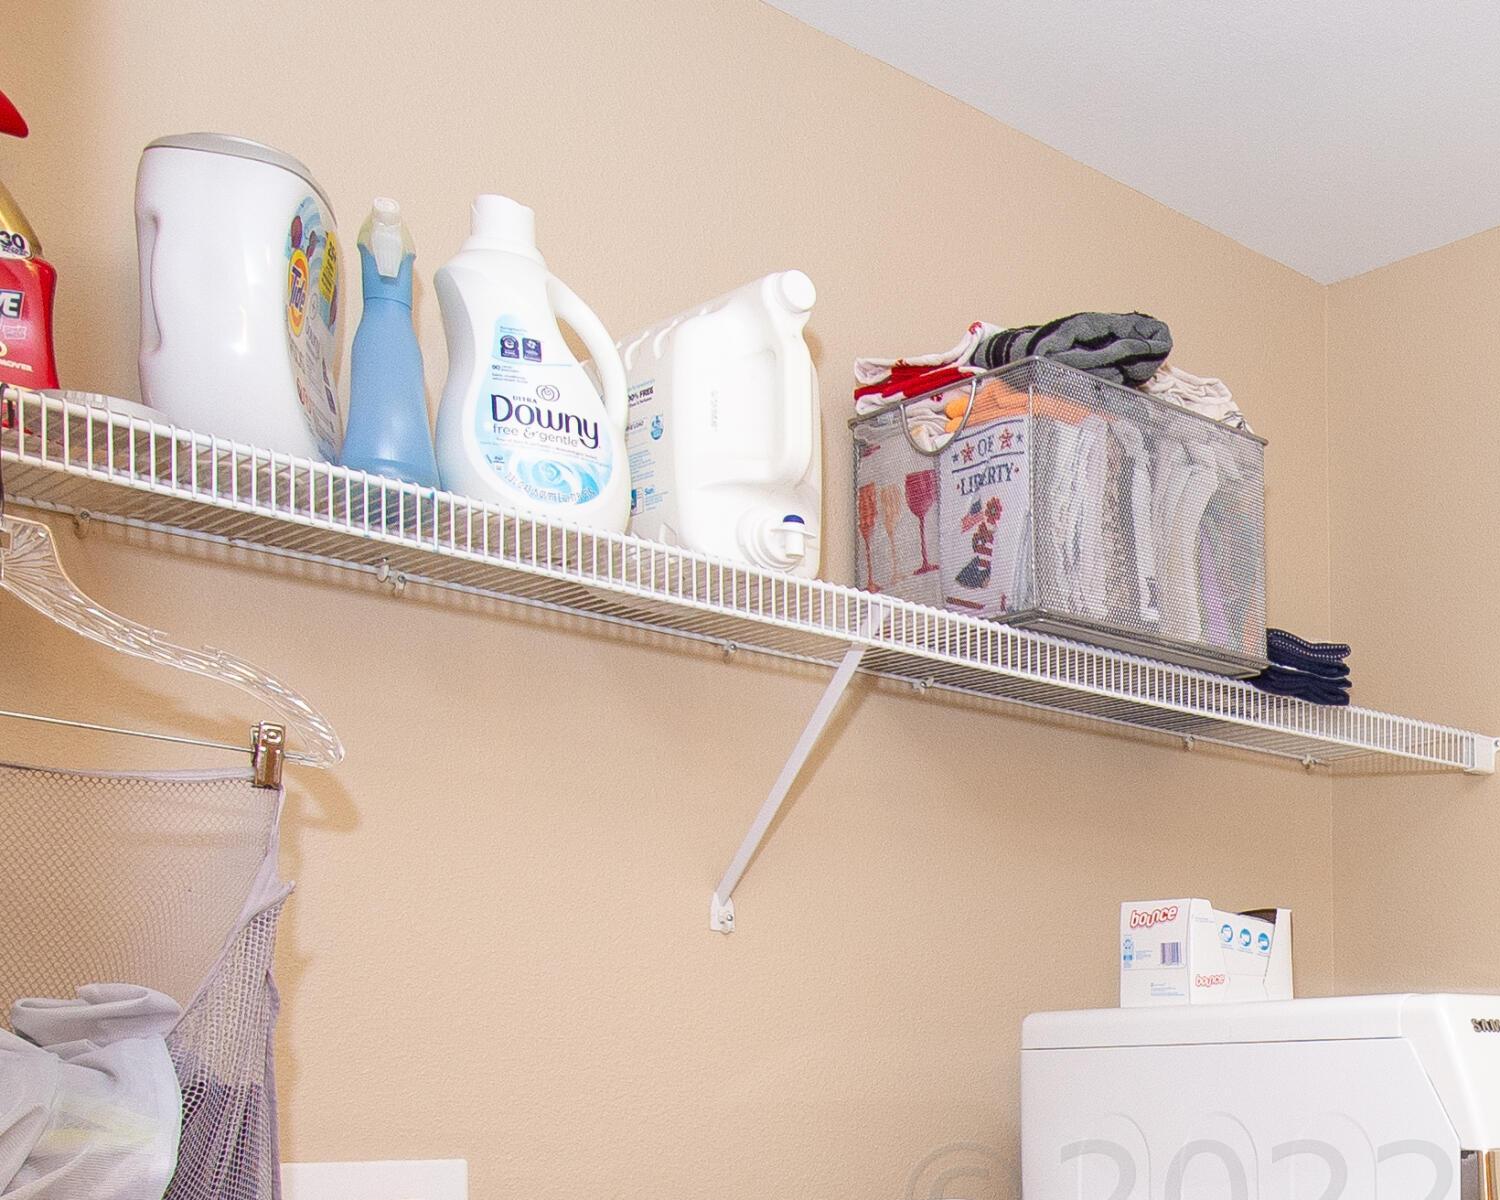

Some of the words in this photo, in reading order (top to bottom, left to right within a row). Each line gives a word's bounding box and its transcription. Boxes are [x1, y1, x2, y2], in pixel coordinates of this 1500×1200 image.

[490, 393, 600, 450] Downy
[493, 423, 519, 437] free
[539, 430, 578, 448] gentle
[977, 435, 995, 457] OF
[960, 462, 1014, 496] LIBERTY
[1129, 905, 1179, 929] bounce
[1195, 973, 1226, 988] bounce
